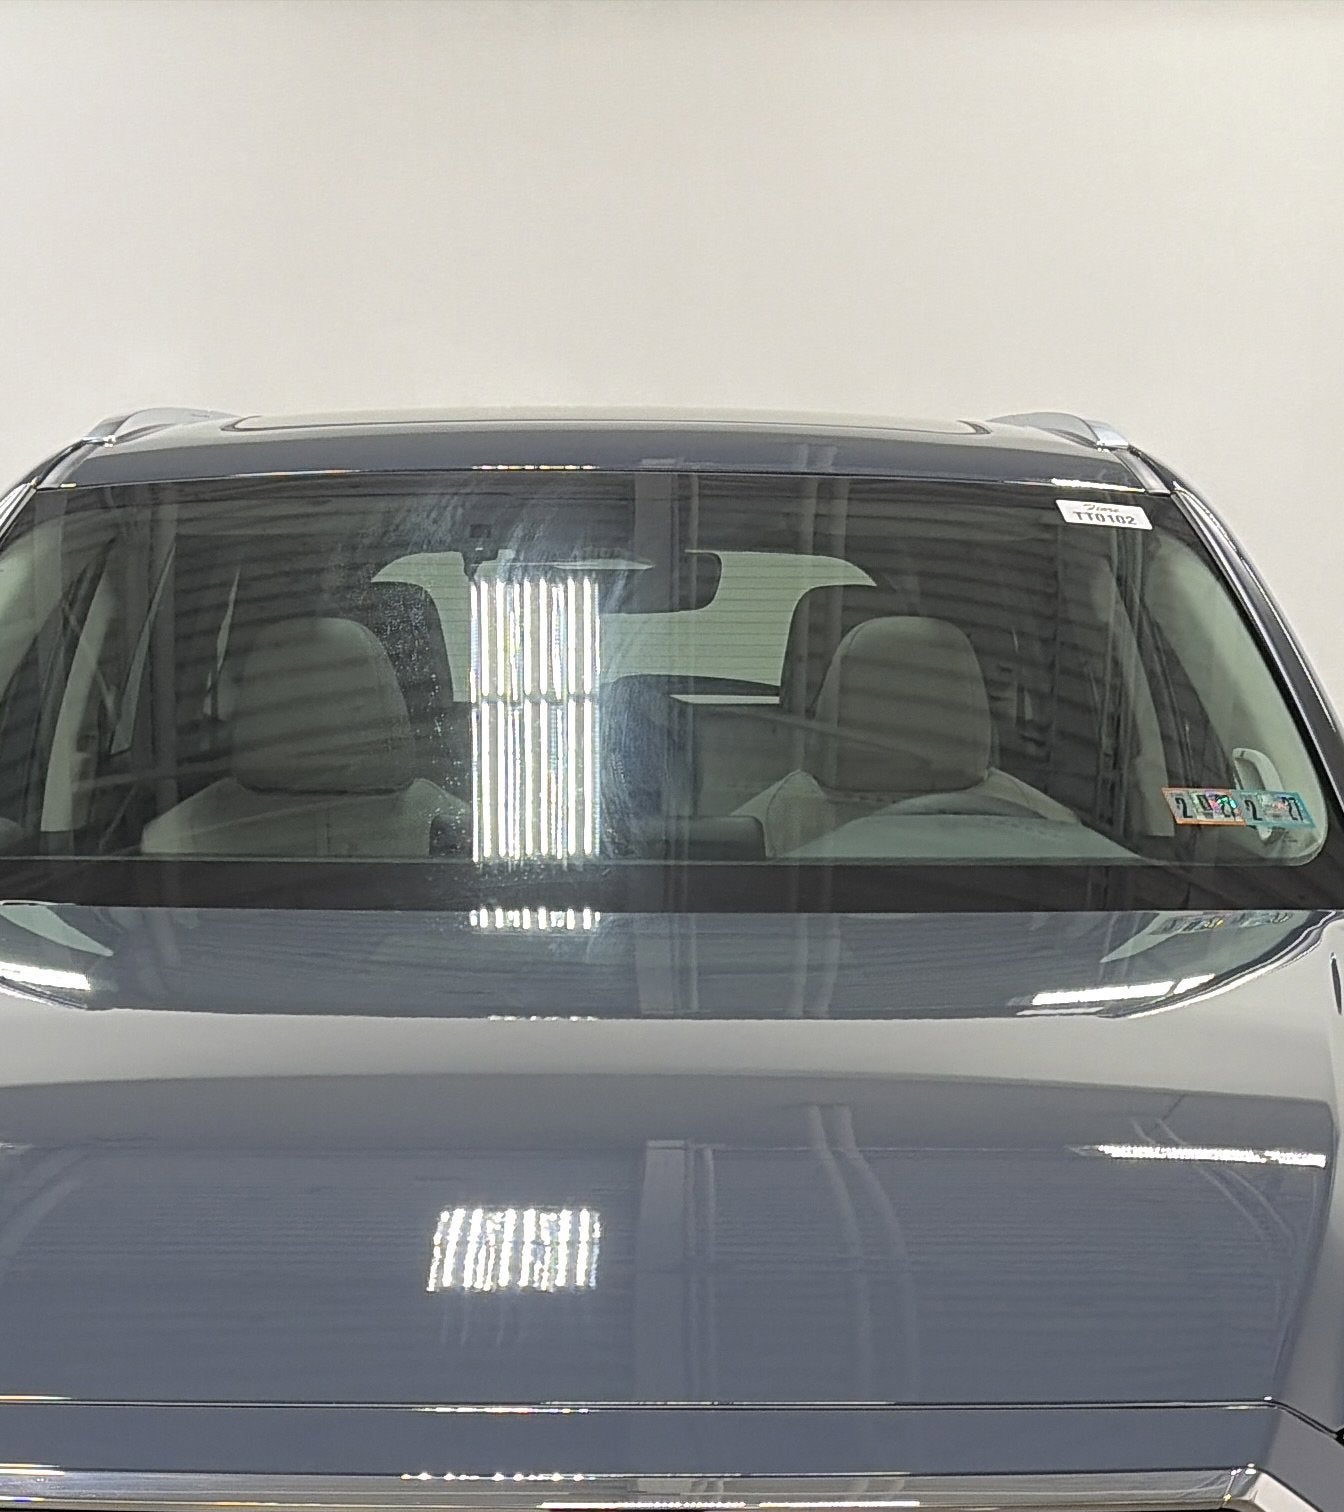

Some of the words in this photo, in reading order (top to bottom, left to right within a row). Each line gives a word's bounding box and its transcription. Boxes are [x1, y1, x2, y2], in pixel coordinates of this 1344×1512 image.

[1073, 511, 1136, 525] TT0102
[1175, 797, 1193, 819] 2
[1244, 799, 1263, 821] 2
